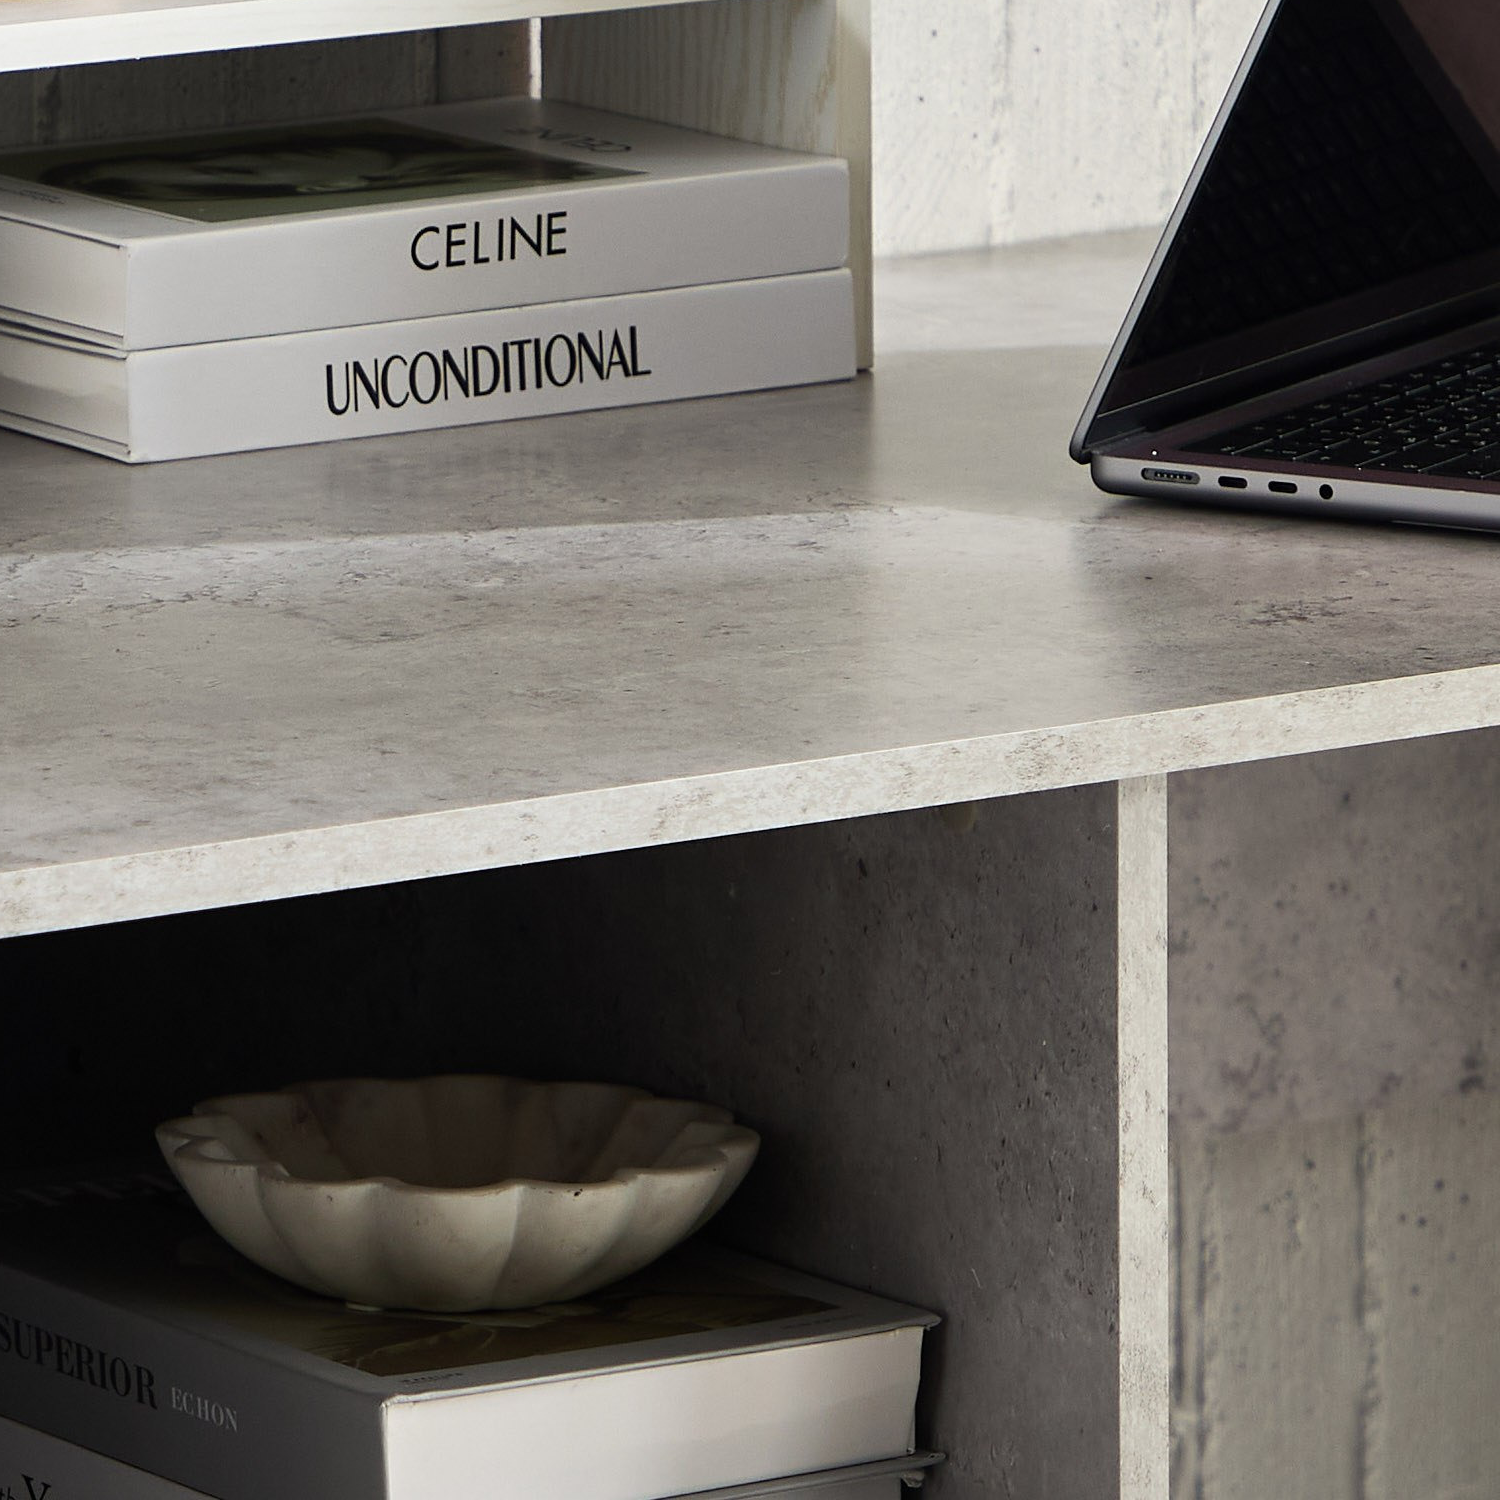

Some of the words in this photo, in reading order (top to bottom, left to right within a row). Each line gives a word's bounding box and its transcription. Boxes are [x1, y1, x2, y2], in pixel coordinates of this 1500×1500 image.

[411, 211, 567, 271] CELINE
[326, 326, 652, 415] UNCONDITIONAL
[171, 1387, 238, 1432] ECHON
